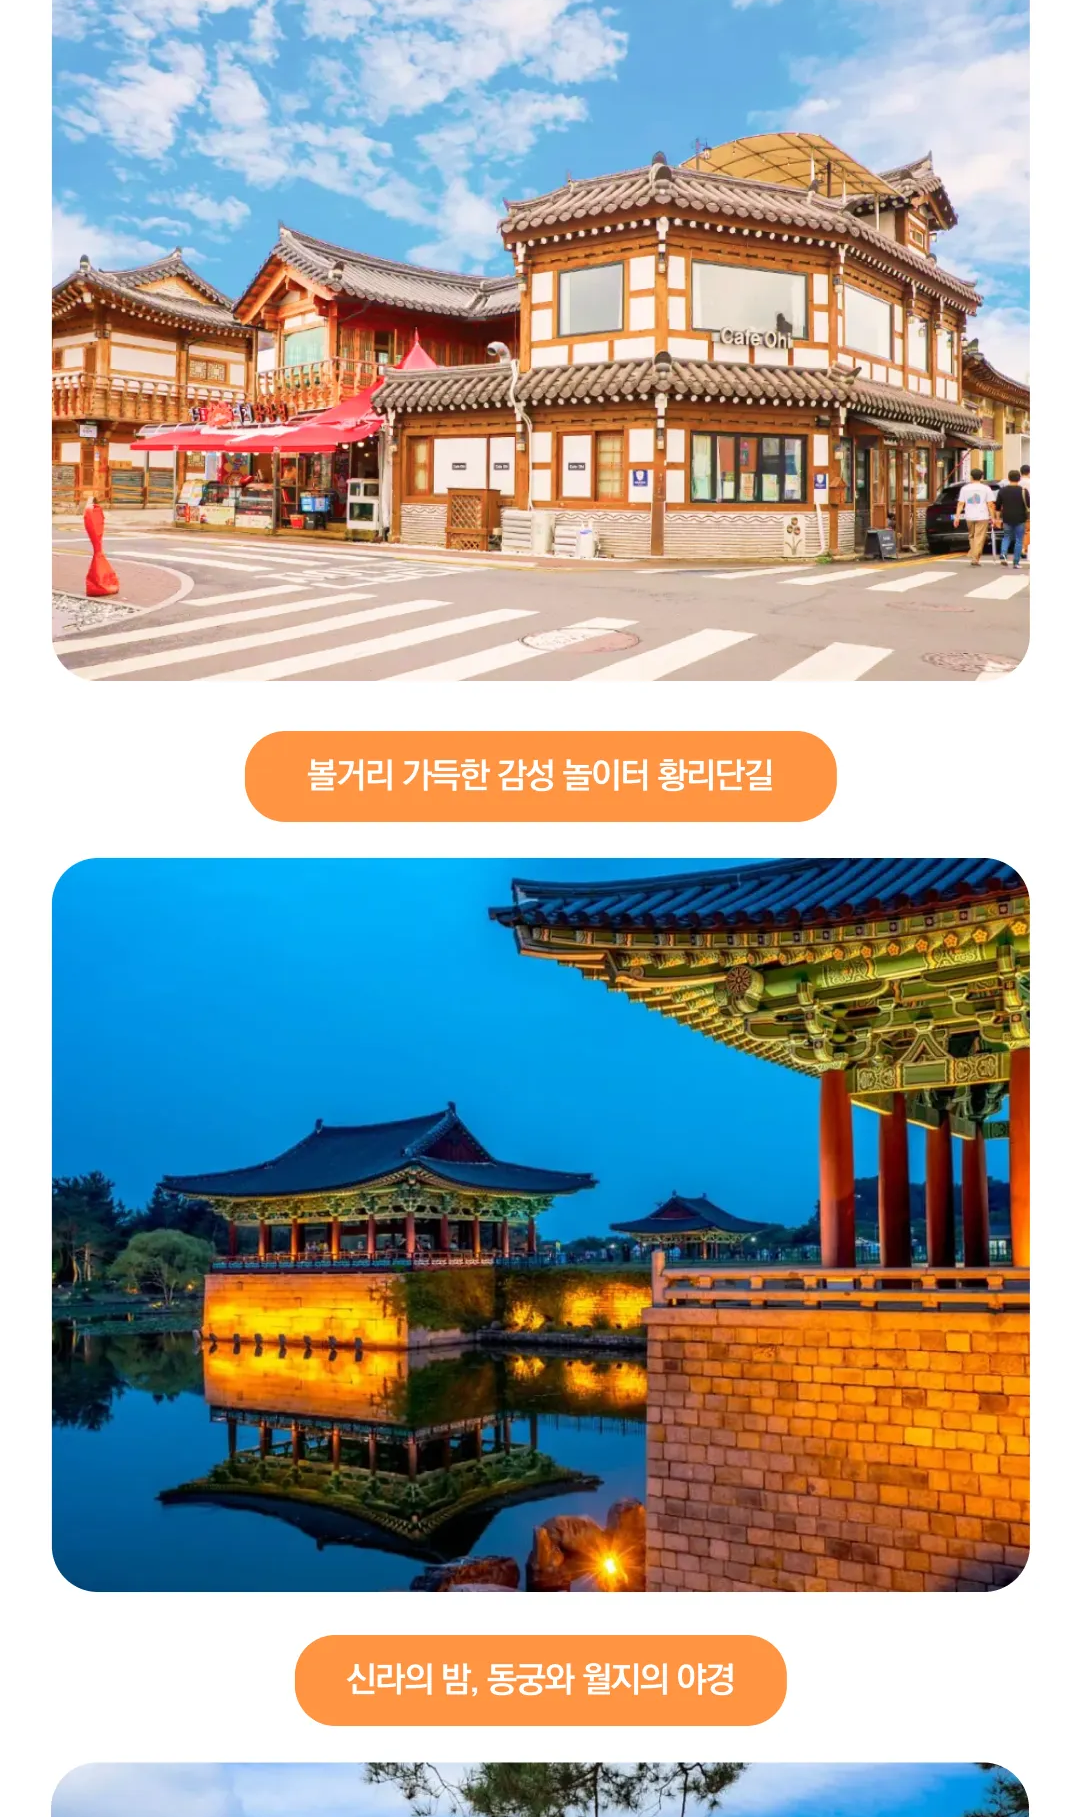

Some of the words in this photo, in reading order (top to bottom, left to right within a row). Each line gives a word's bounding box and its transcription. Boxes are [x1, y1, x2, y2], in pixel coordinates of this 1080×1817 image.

[721, 326, 761, 346] Cafe
[763, 329, 793, 350] Ohi
[347, 1663, 432, 1695] 신라의
[443, 1663, 477, 1696] 밤,
[488, 1663, 575, 1695] 동궁와
[583, 1663, 667, 1695] 월지의
[678, 1663, 733, 1695] 야경
